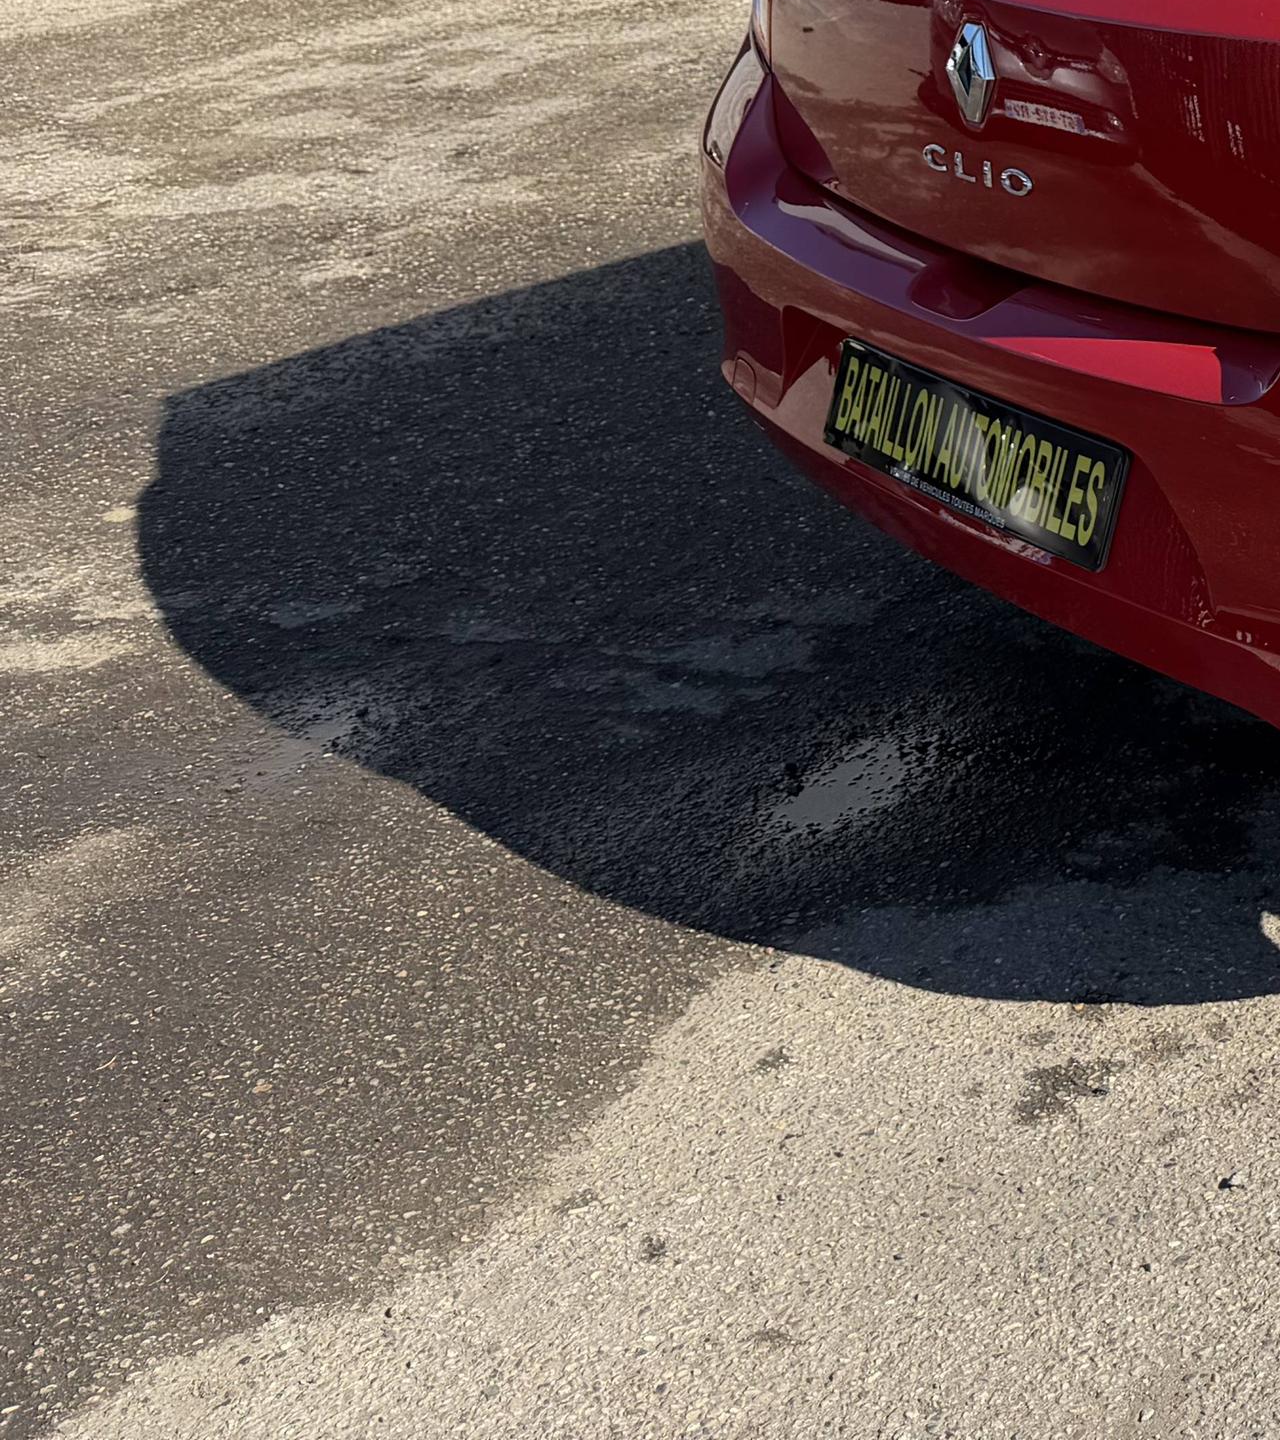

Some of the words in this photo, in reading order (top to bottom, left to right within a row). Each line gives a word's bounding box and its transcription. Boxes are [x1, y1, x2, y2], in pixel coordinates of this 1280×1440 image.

[922, 143, 1034, 197] CLIO
[835, 357, 943, 472] BATAILLON
[937, 400, 1105, 546] AUTOMOBILES
